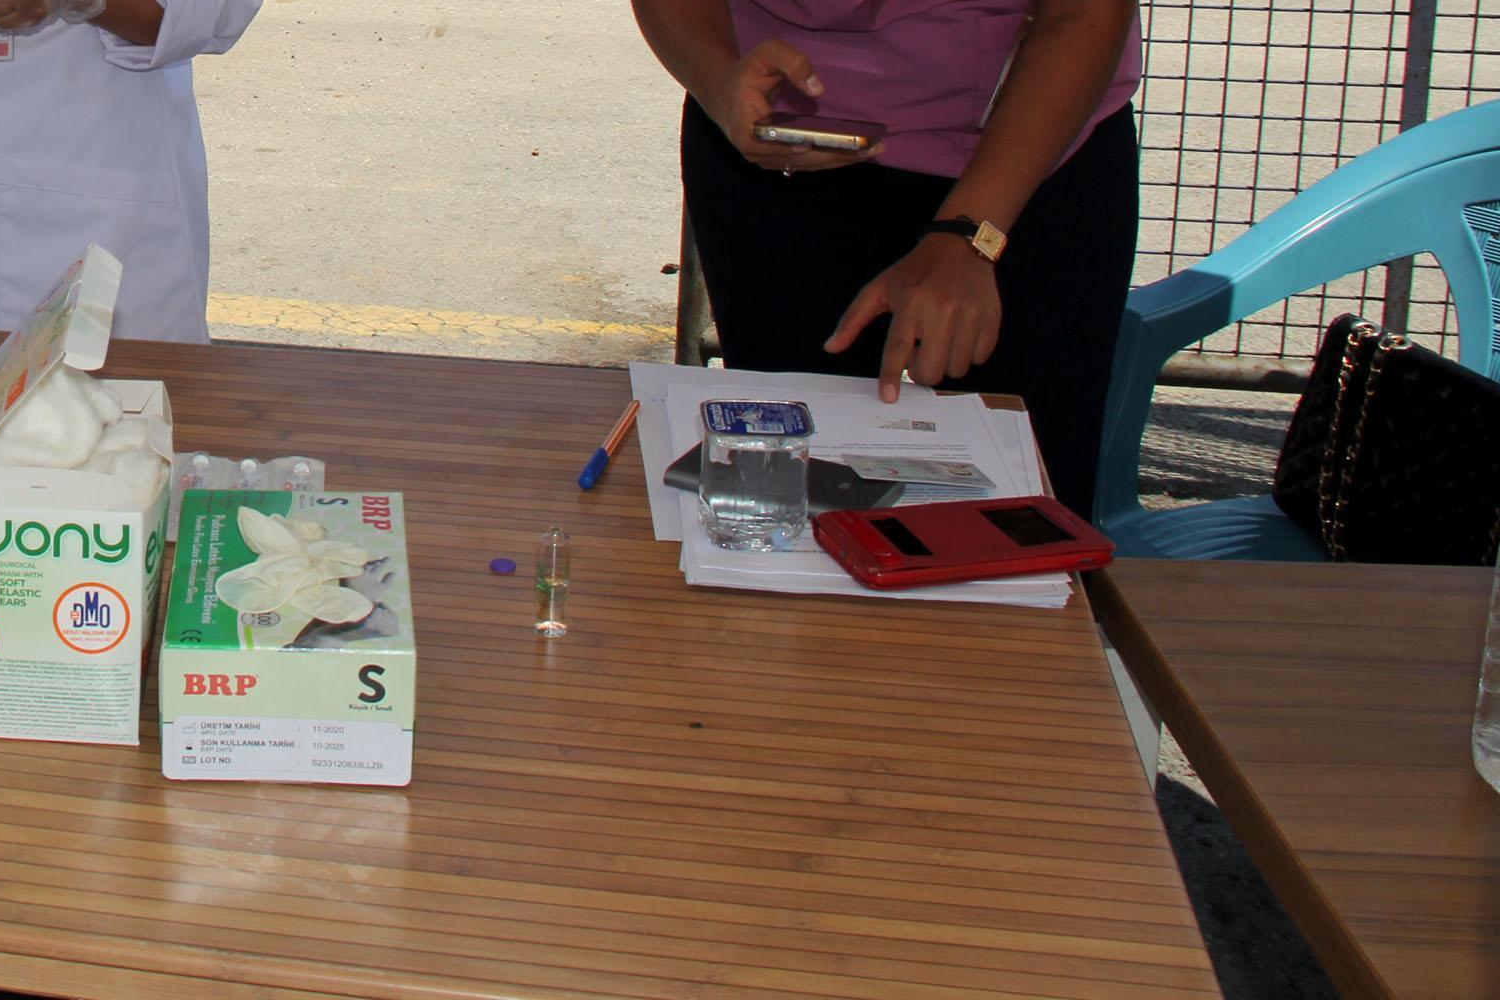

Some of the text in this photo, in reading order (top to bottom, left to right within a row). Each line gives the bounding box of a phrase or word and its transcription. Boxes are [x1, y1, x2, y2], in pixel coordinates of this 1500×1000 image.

[316, 497, 349, 505] S
[362, 495, 391, 530] BRP
[0, 561, 36, 569] SURGICAL
[0, 578, 26, 587] SOFT
[0, 588, 42, 598] ELASTIC
[0, 598, 27, 607] EARS
[183, 674, 257, 695] BRP
[357, 664, 386, 703] S
[201, 721, 260, 731] ÜRETİM TARİHİ
[312, 726, 344, 734] 11-2020
[268, 739, 295, 748] TARİHİ
[312, 742, 345, 750] 10-2025
[200, 756, 215, 764] LOT
